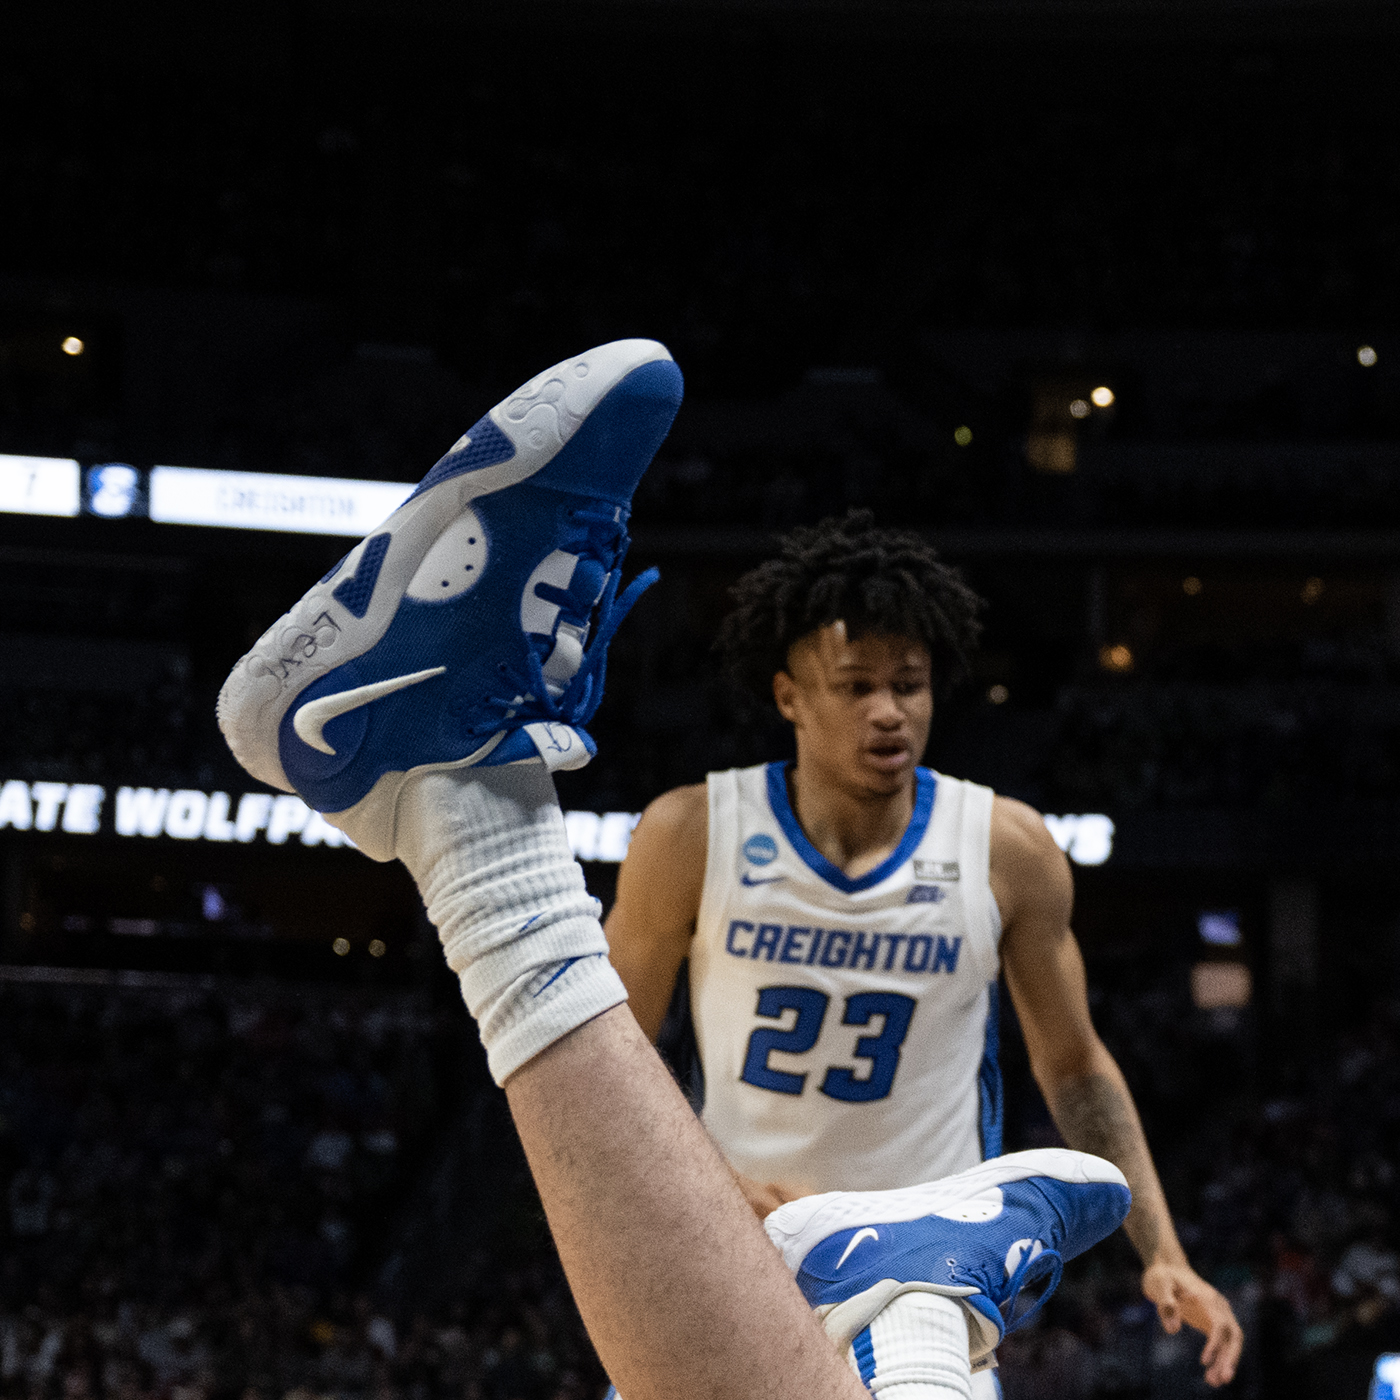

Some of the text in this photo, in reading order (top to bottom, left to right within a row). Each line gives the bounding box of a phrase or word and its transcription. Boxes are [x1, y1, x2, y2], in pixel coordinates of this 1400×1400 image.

[0, 779, 358, 849] ATE WOLFPA
[725, 919, 962, 974] CREIGHTON
[739, 984, 918, 1104] 23
